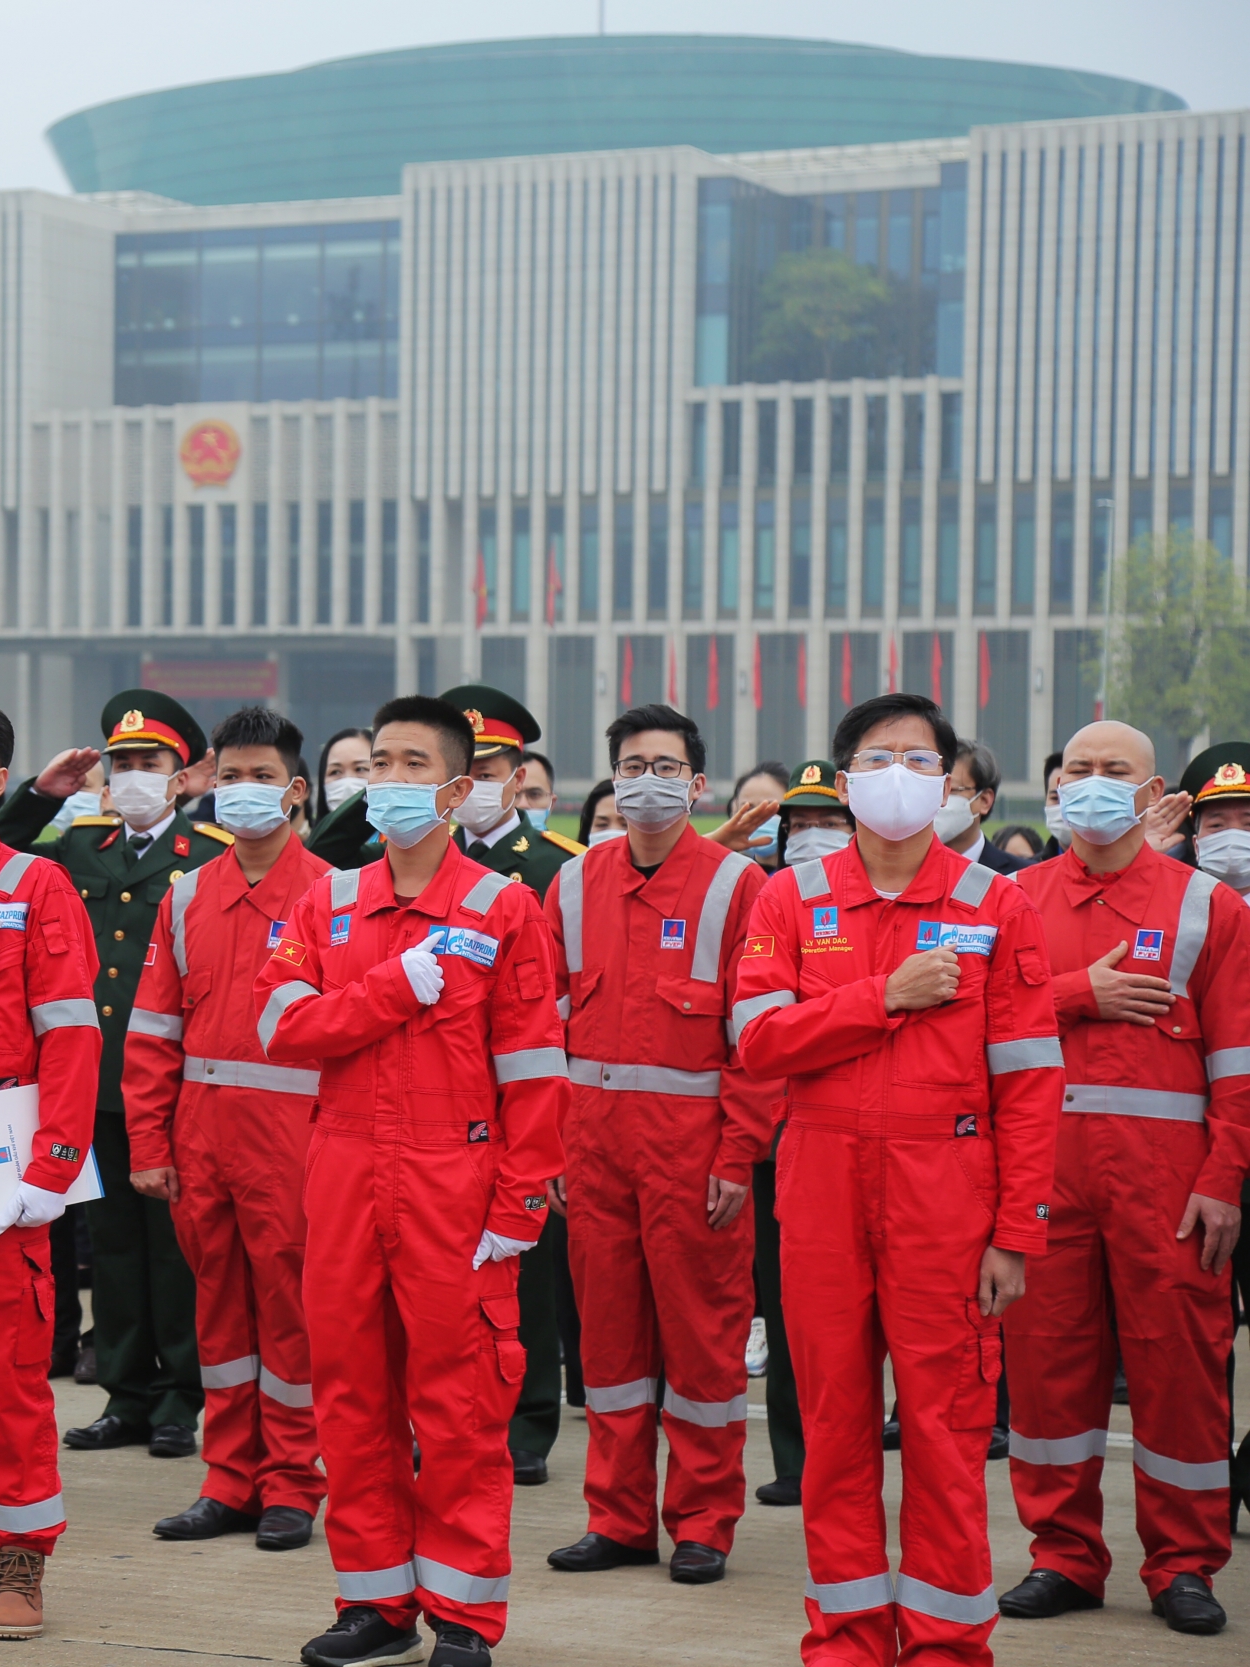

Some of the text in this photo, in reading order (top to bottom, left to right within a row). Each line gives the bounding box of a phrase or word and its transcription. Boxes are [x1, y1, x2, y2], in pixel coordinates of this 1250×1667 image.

[816, 937, 831, 946] VAN
[832, 937, 848, 945] DAO
[958, 933, 996, 946] GAZPROM
[800, 945, 854, 954] Operation Manager
